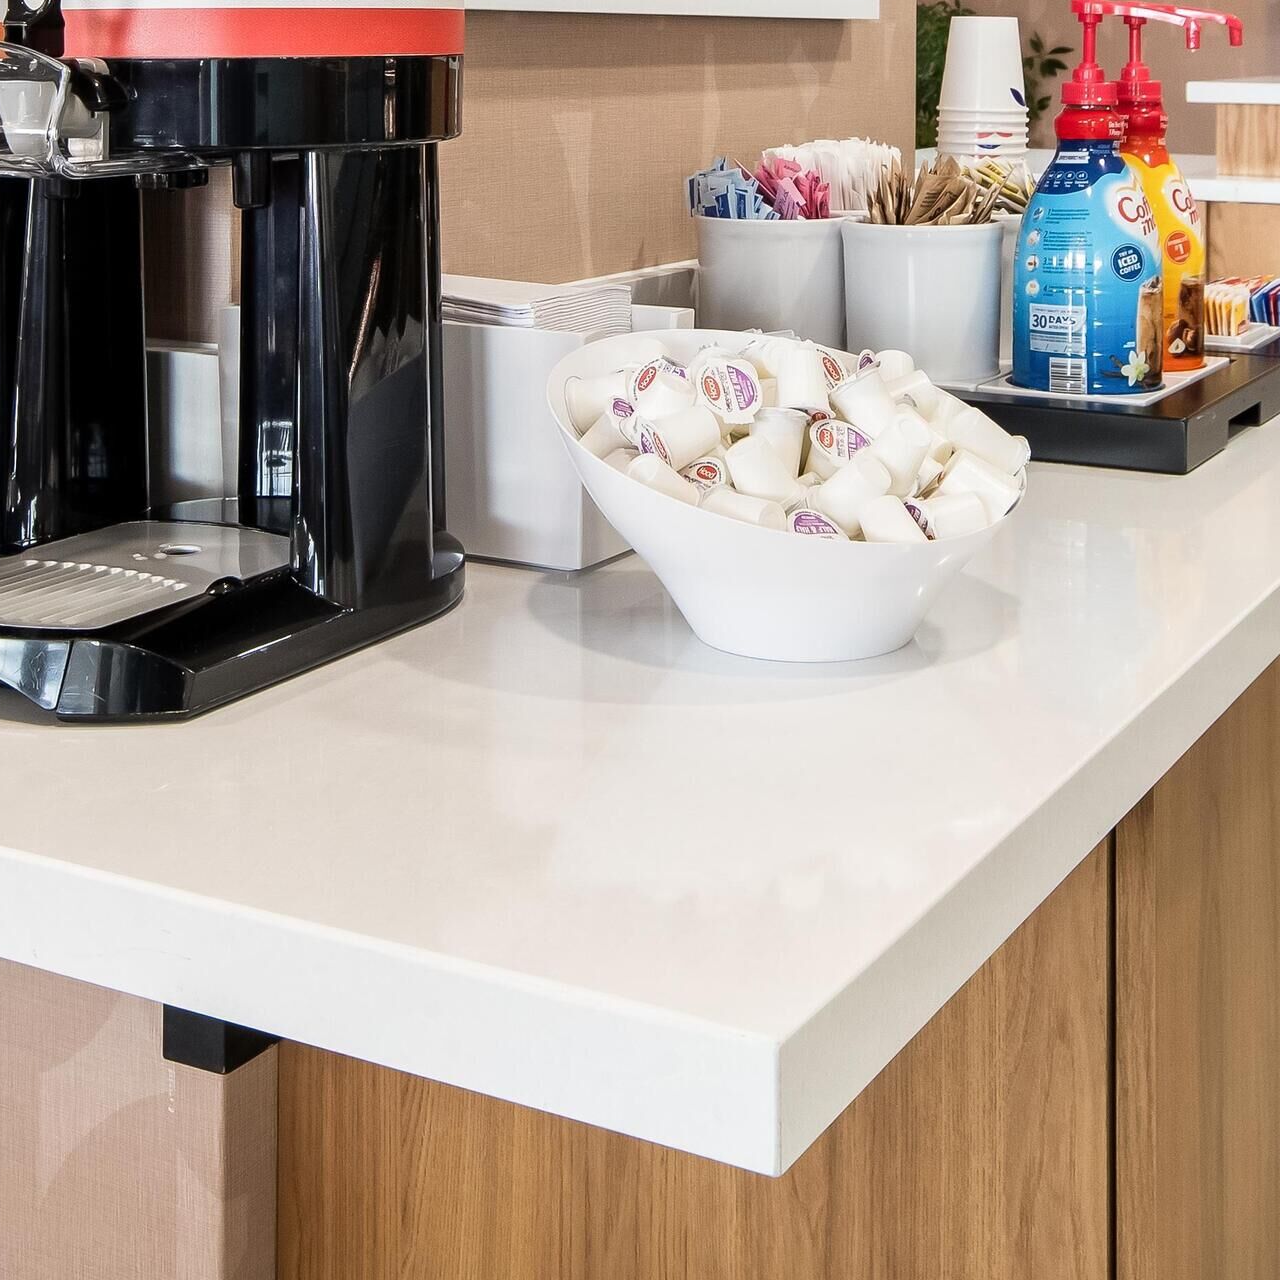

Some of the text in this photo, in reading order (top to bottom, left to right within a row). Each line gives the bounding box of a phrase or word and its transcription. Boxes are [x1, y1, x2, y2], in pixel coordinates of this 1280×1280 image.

[1118, 253, 1138, 268] ICED
[1120, 262, 1141, 275] COFFEE
[1032, 314, 1047, 329] 30
[638, 368, 656, 390] Hood
[705, 377, 720, 400] Hood
[697, 466, 717, 479] Hood
